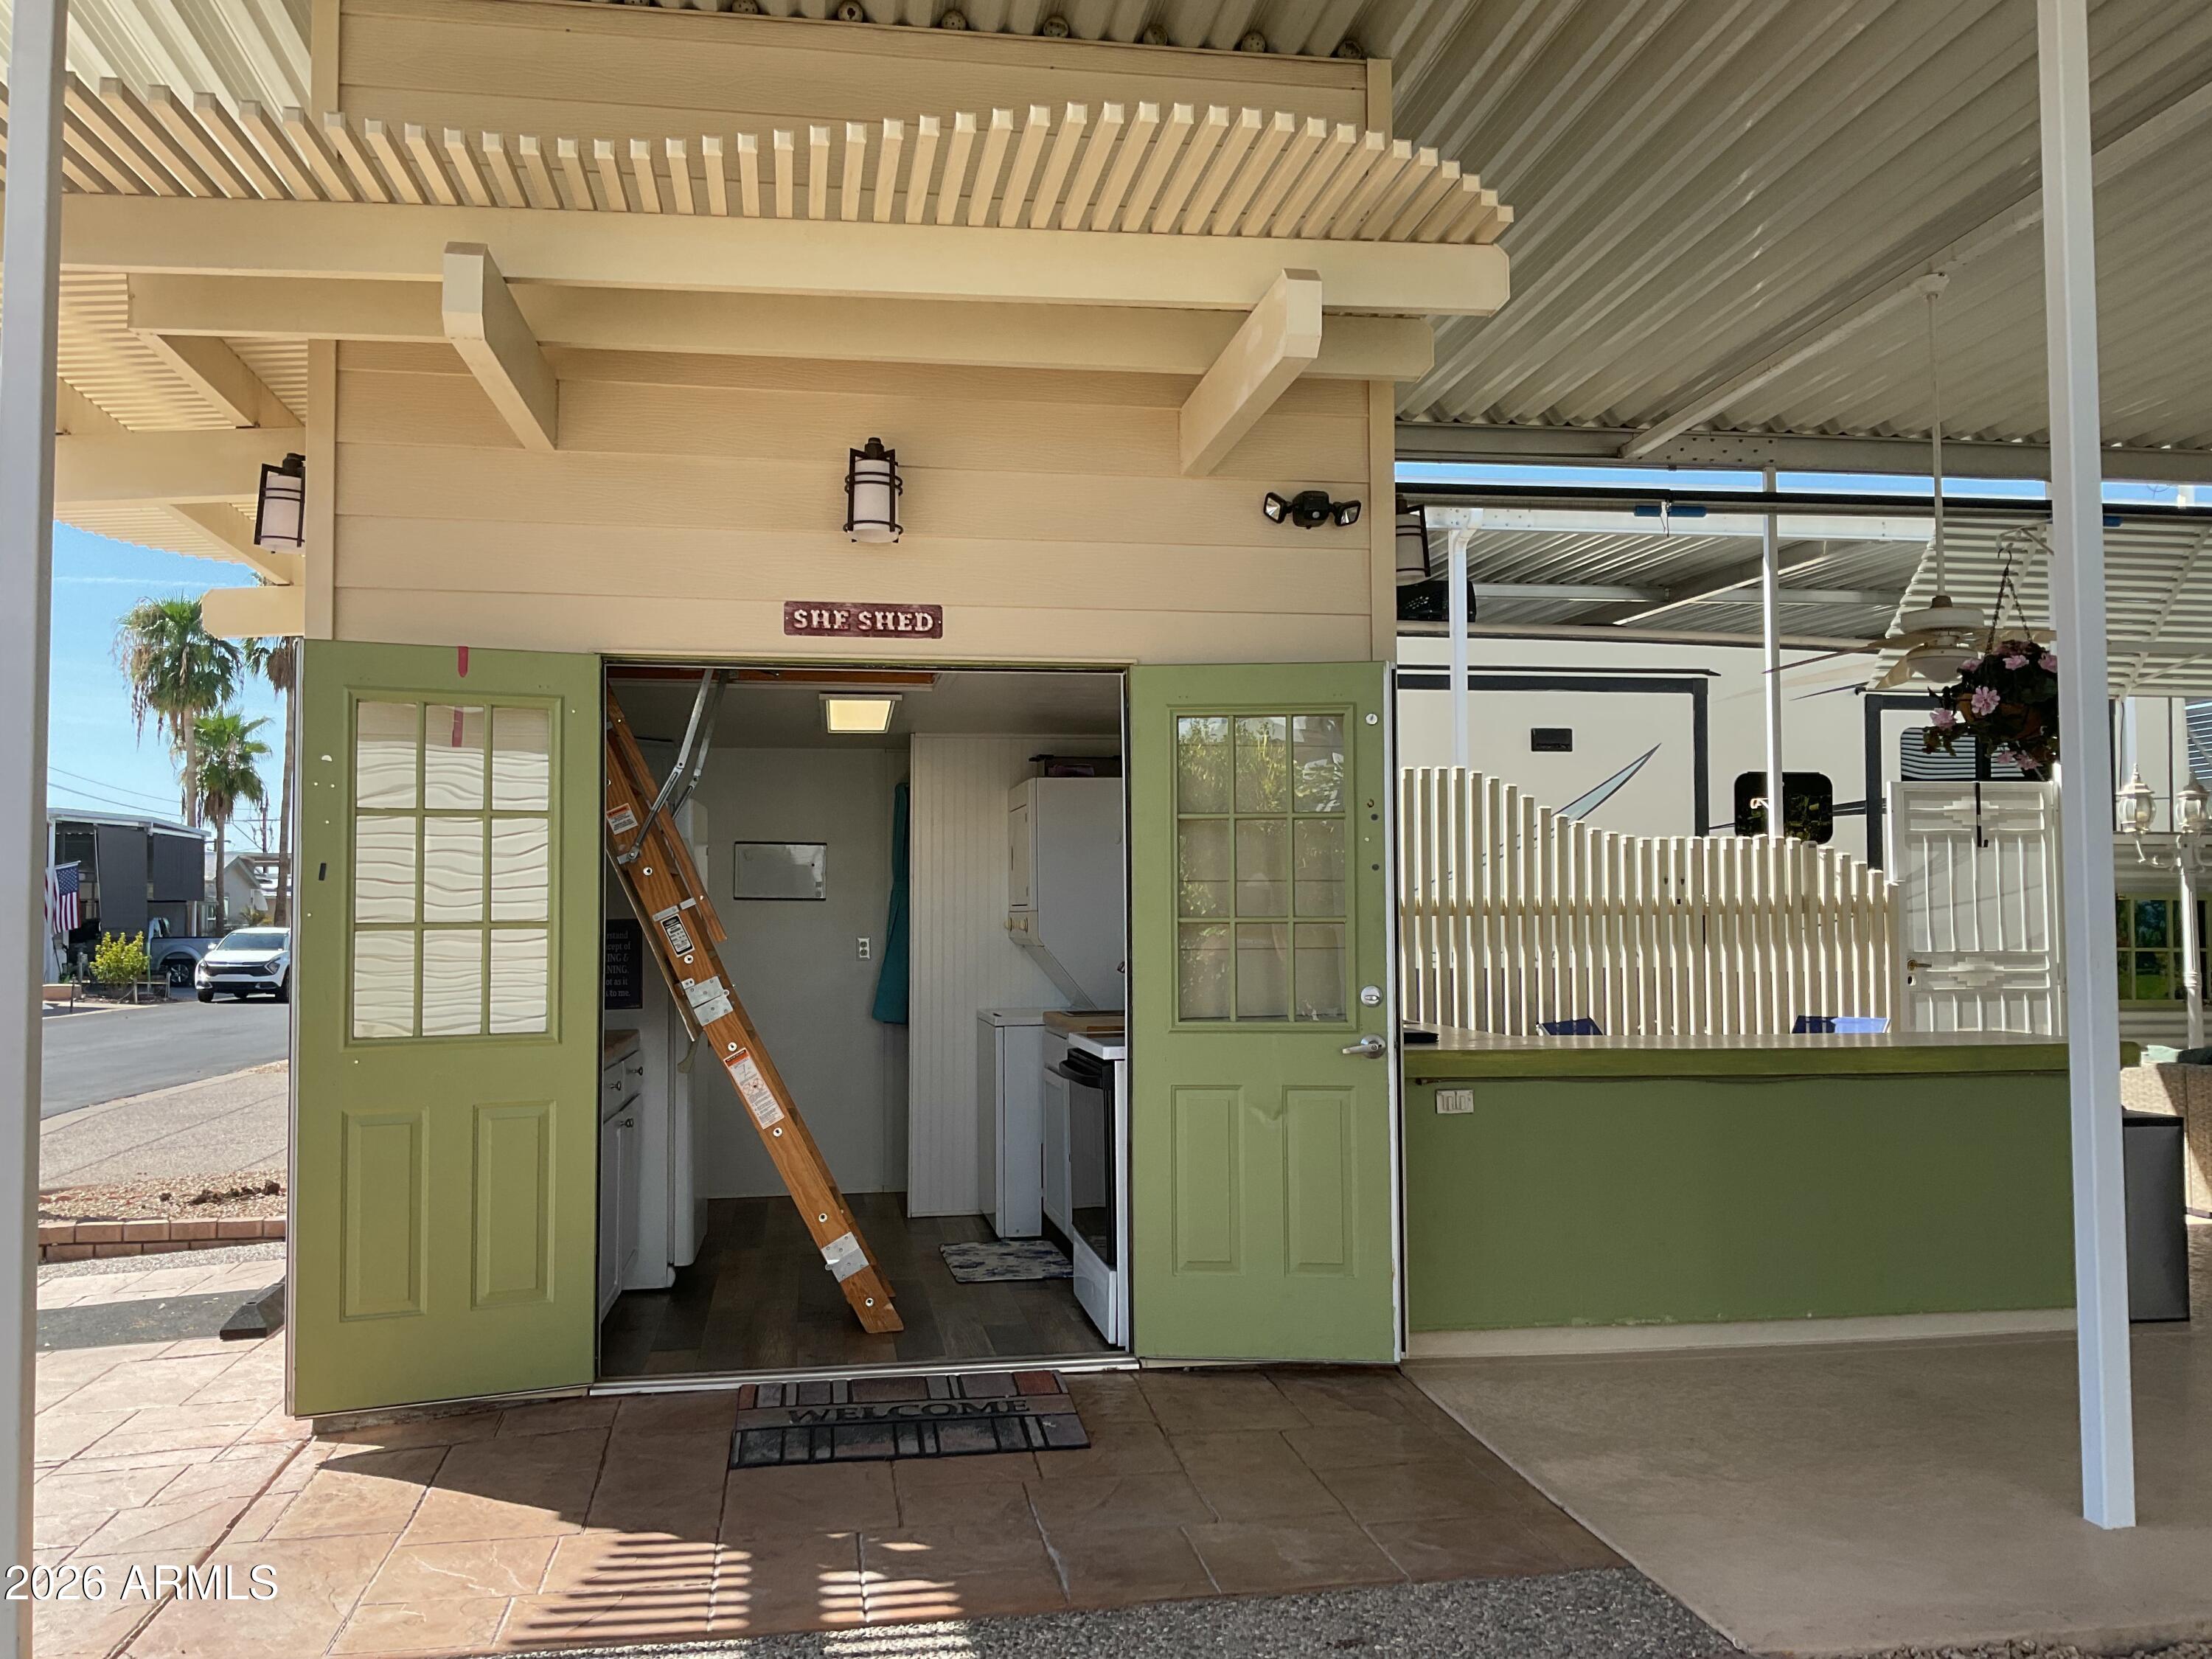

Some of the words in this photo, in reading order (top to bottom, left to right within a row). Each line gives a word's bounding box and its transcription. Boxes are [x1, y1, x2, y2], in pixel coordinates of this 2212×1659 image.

[793, 609, 849, 630] SHE
[858, 611, 934, 632] SHED
[787, 1400, 1030, 1424] WELCOME
